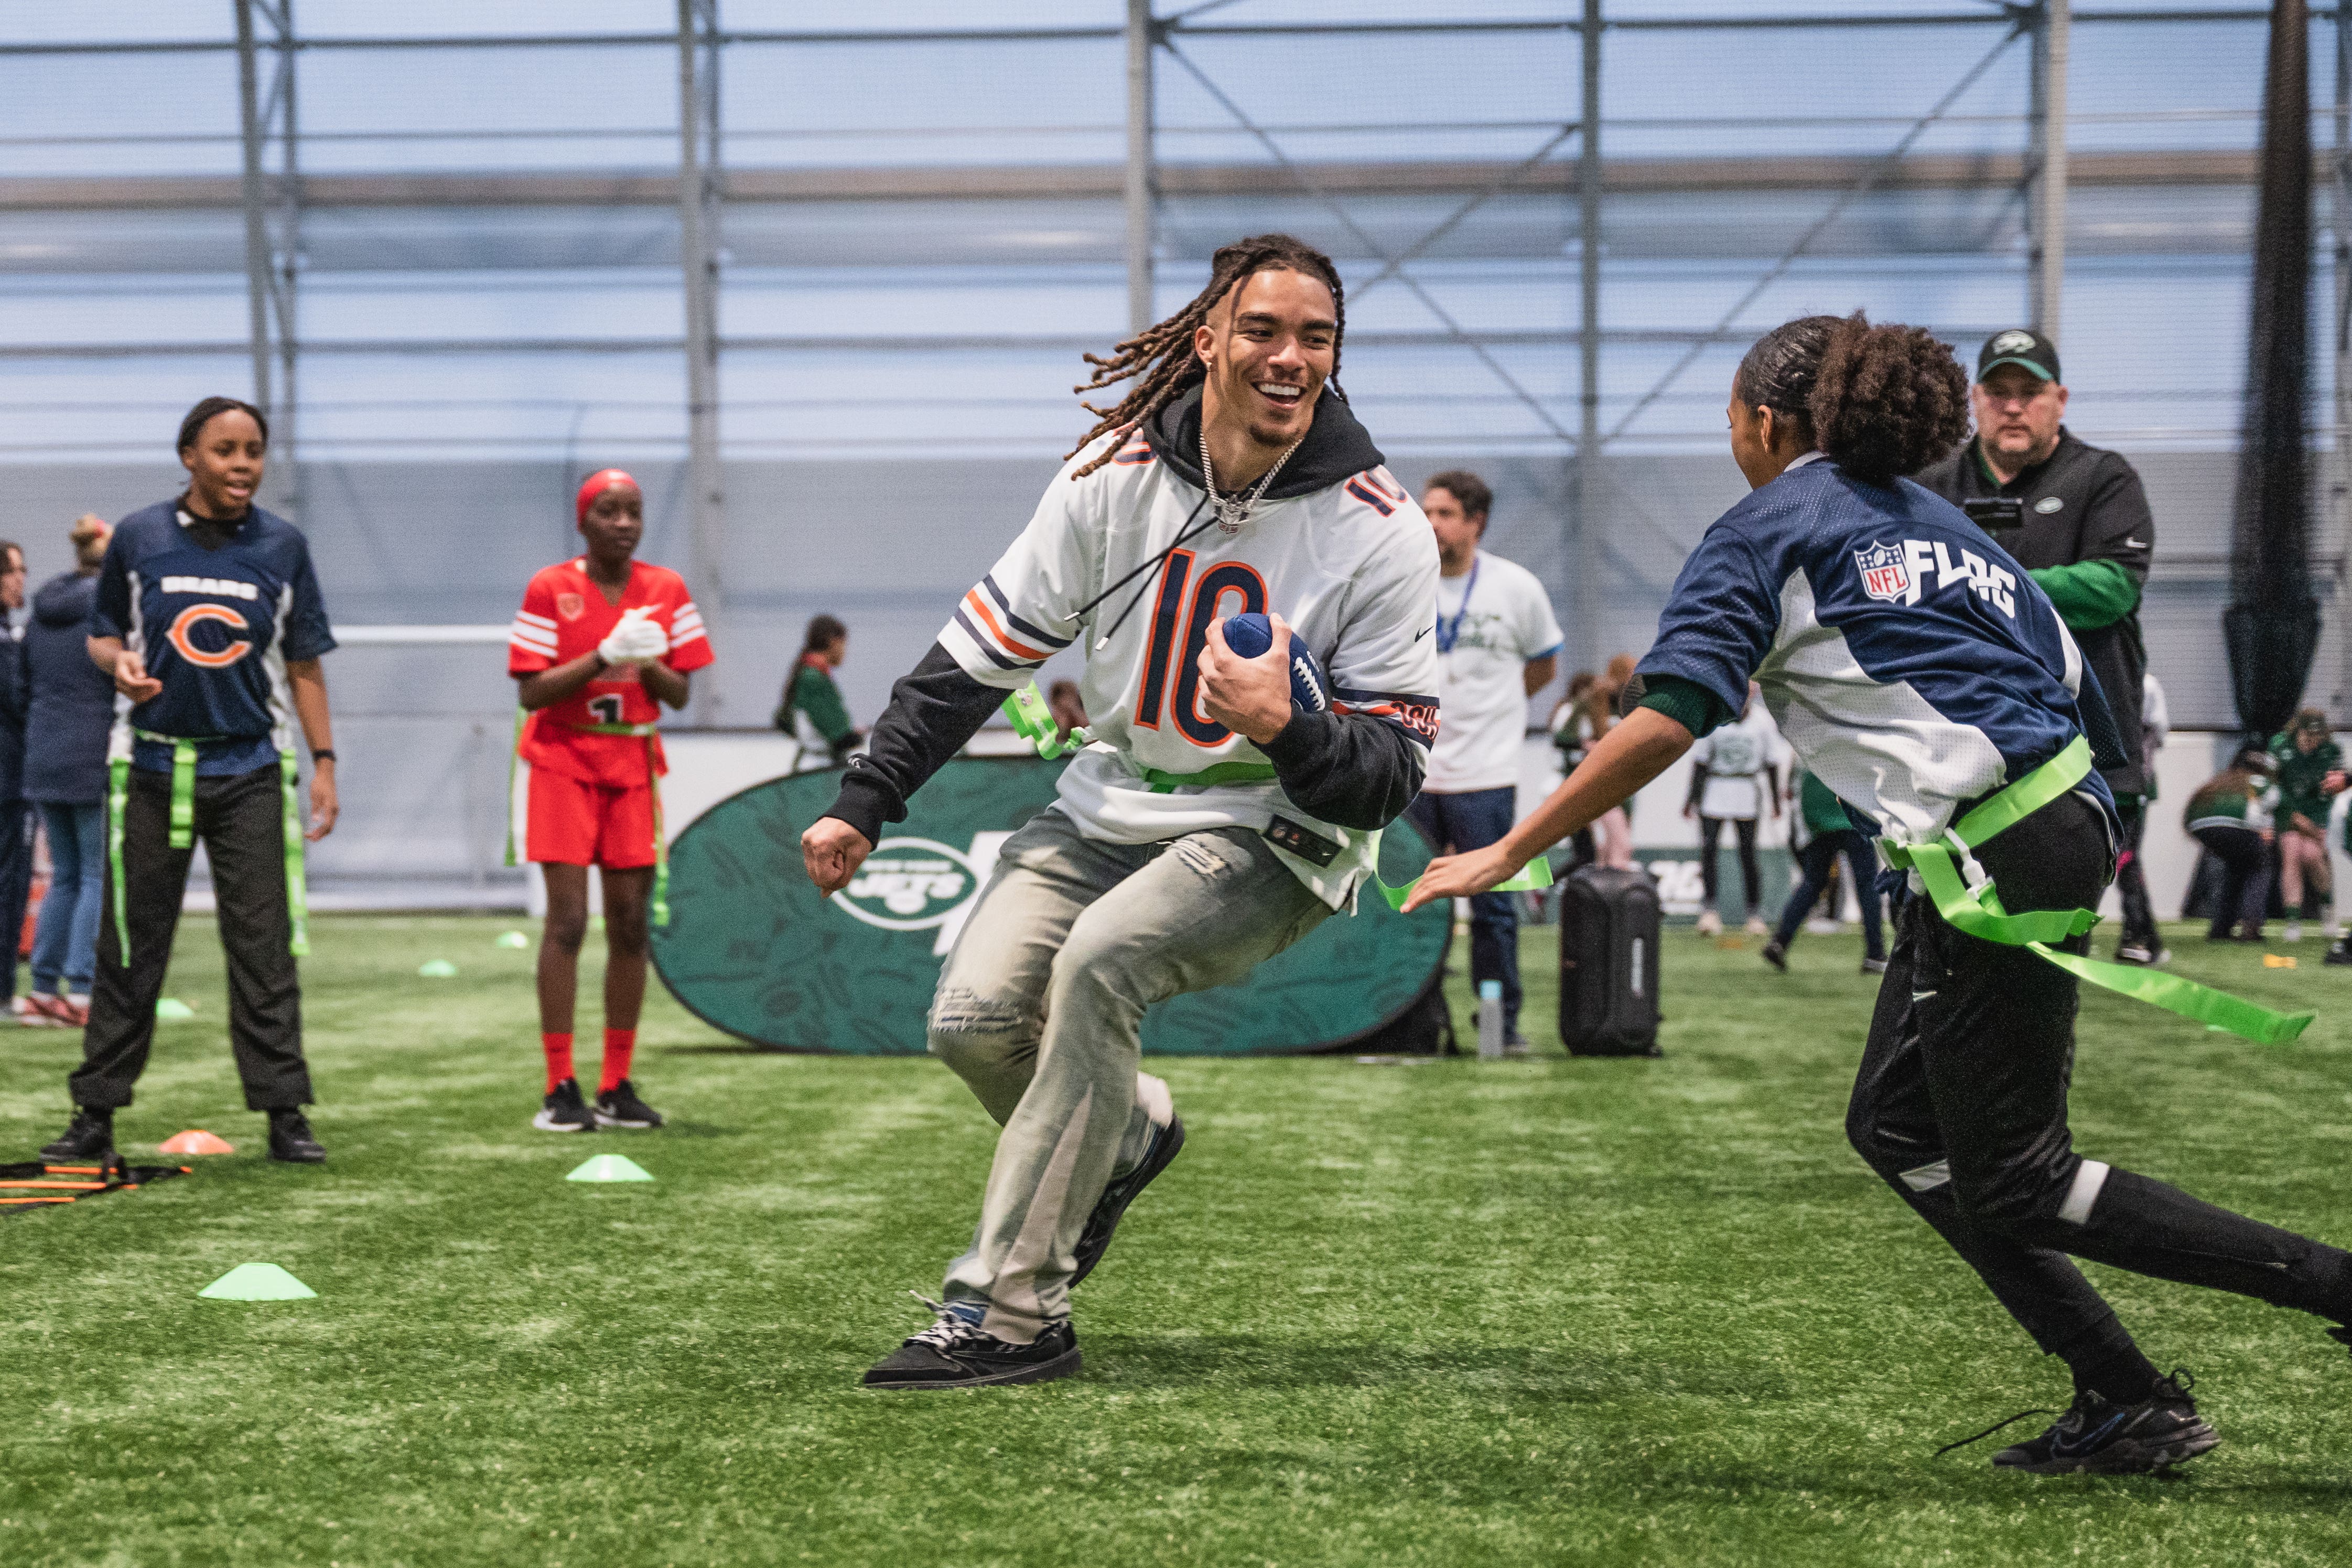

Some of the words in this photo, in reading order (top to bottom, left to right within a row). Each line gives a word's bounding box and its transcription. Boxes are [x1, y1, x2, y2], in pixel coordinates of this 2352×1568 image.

[1867, 567, 1906, 593] NFL
[1904, 539, 2016, 619] FLAG
[165, 603, 254, 668] C
[1134, 547, 1269, 748] 10
